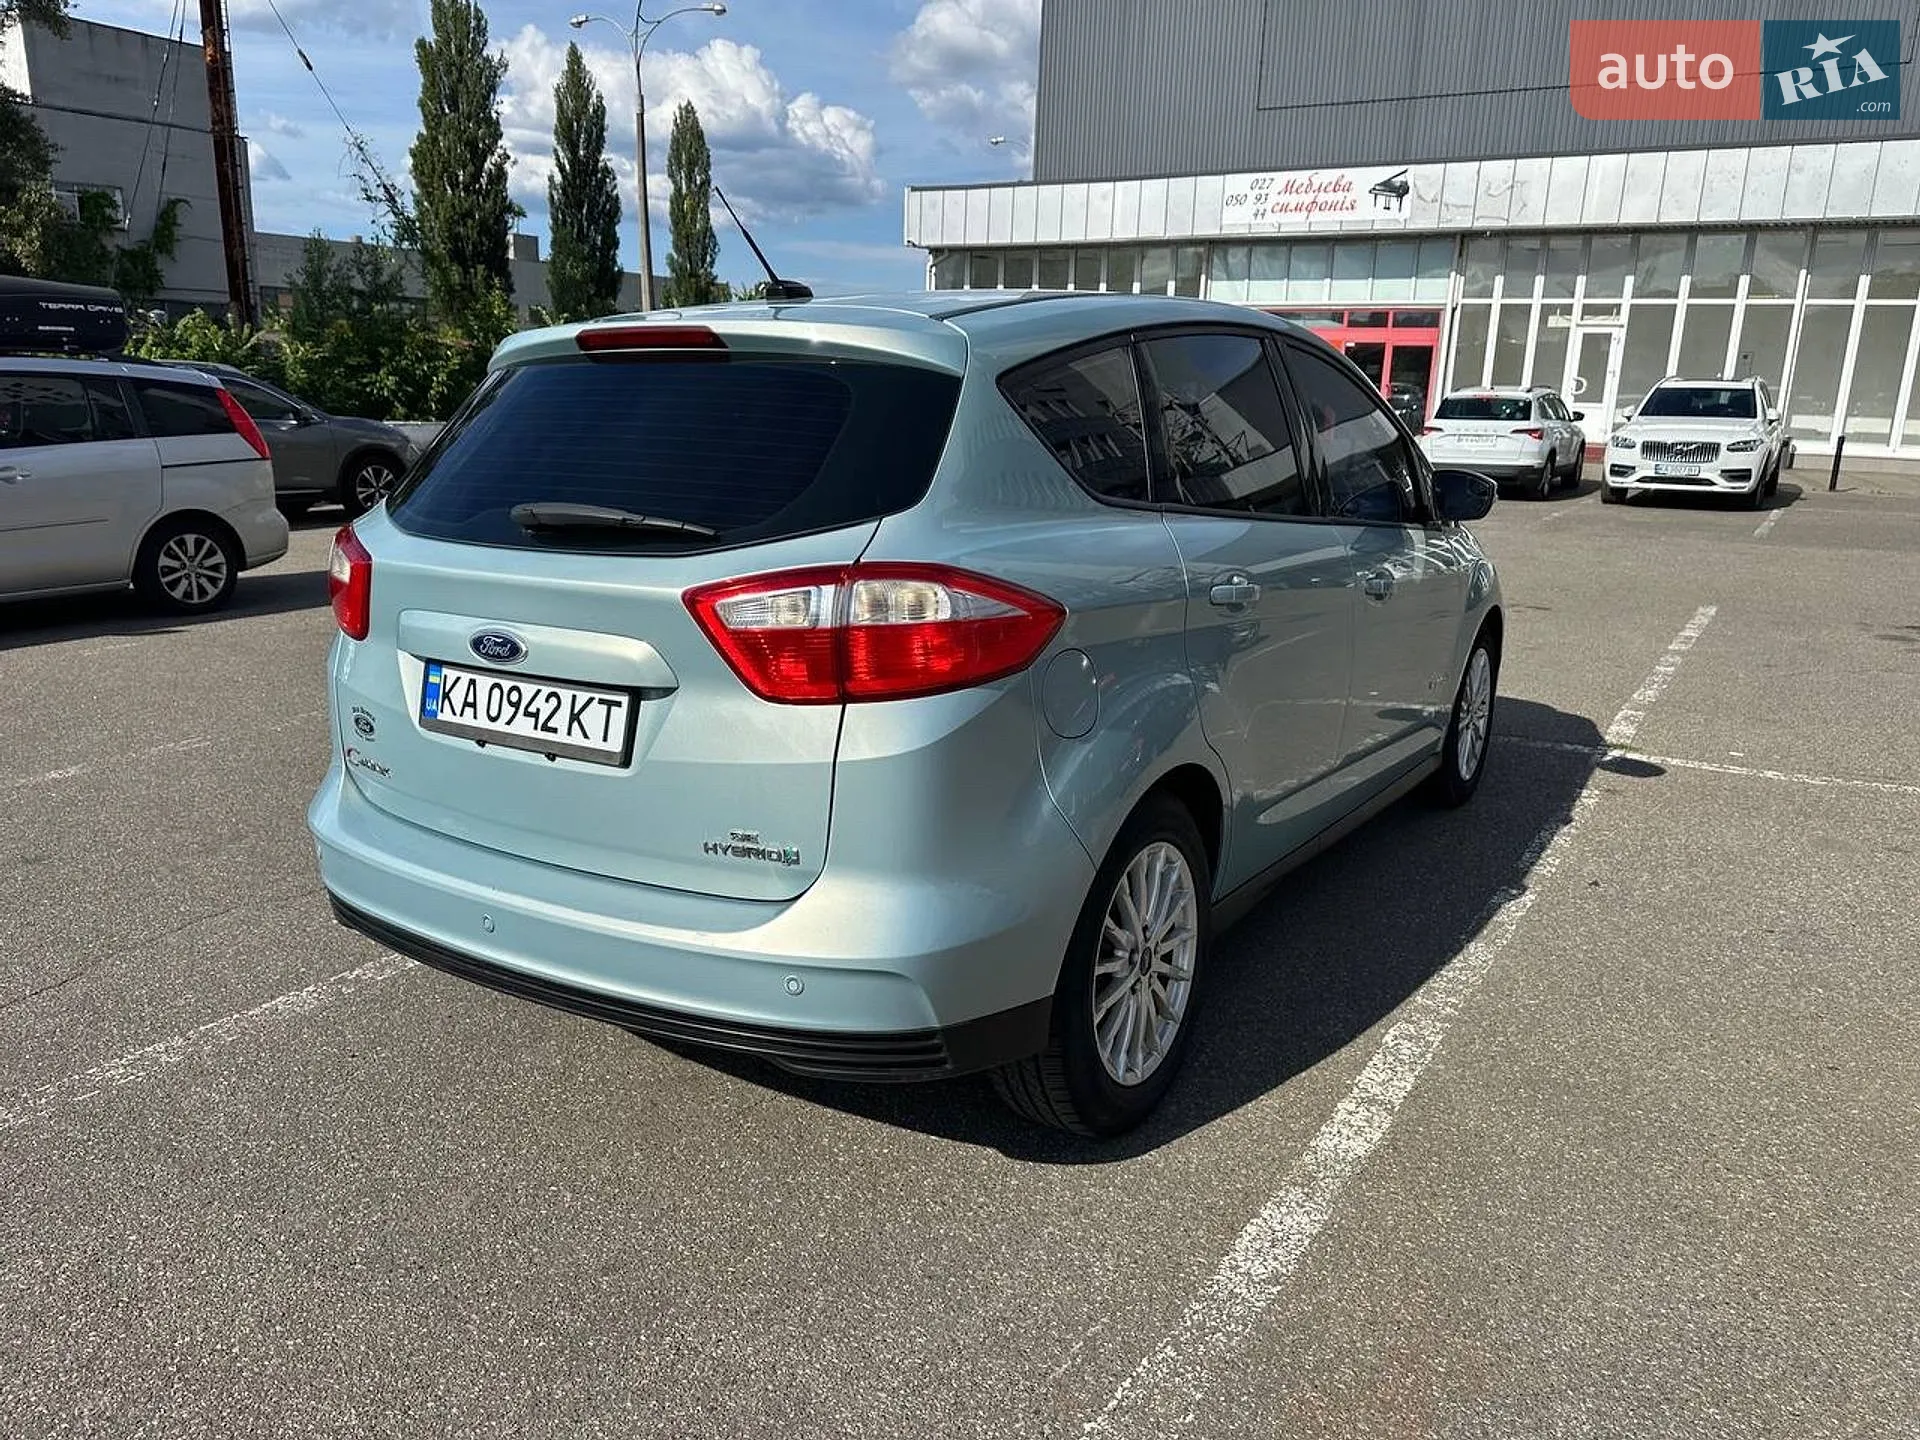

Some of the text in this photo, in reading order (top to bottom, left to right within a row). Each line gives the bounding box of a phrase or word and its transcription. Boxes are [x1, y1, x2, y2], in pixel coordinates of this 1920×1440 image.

[1278, 172, 1353, 195] Меблева
[1271, 196, 1357, 220] симфонія
[479, 636, 513, 658] Ford
[703, 841, 783, 863] HYBRID
